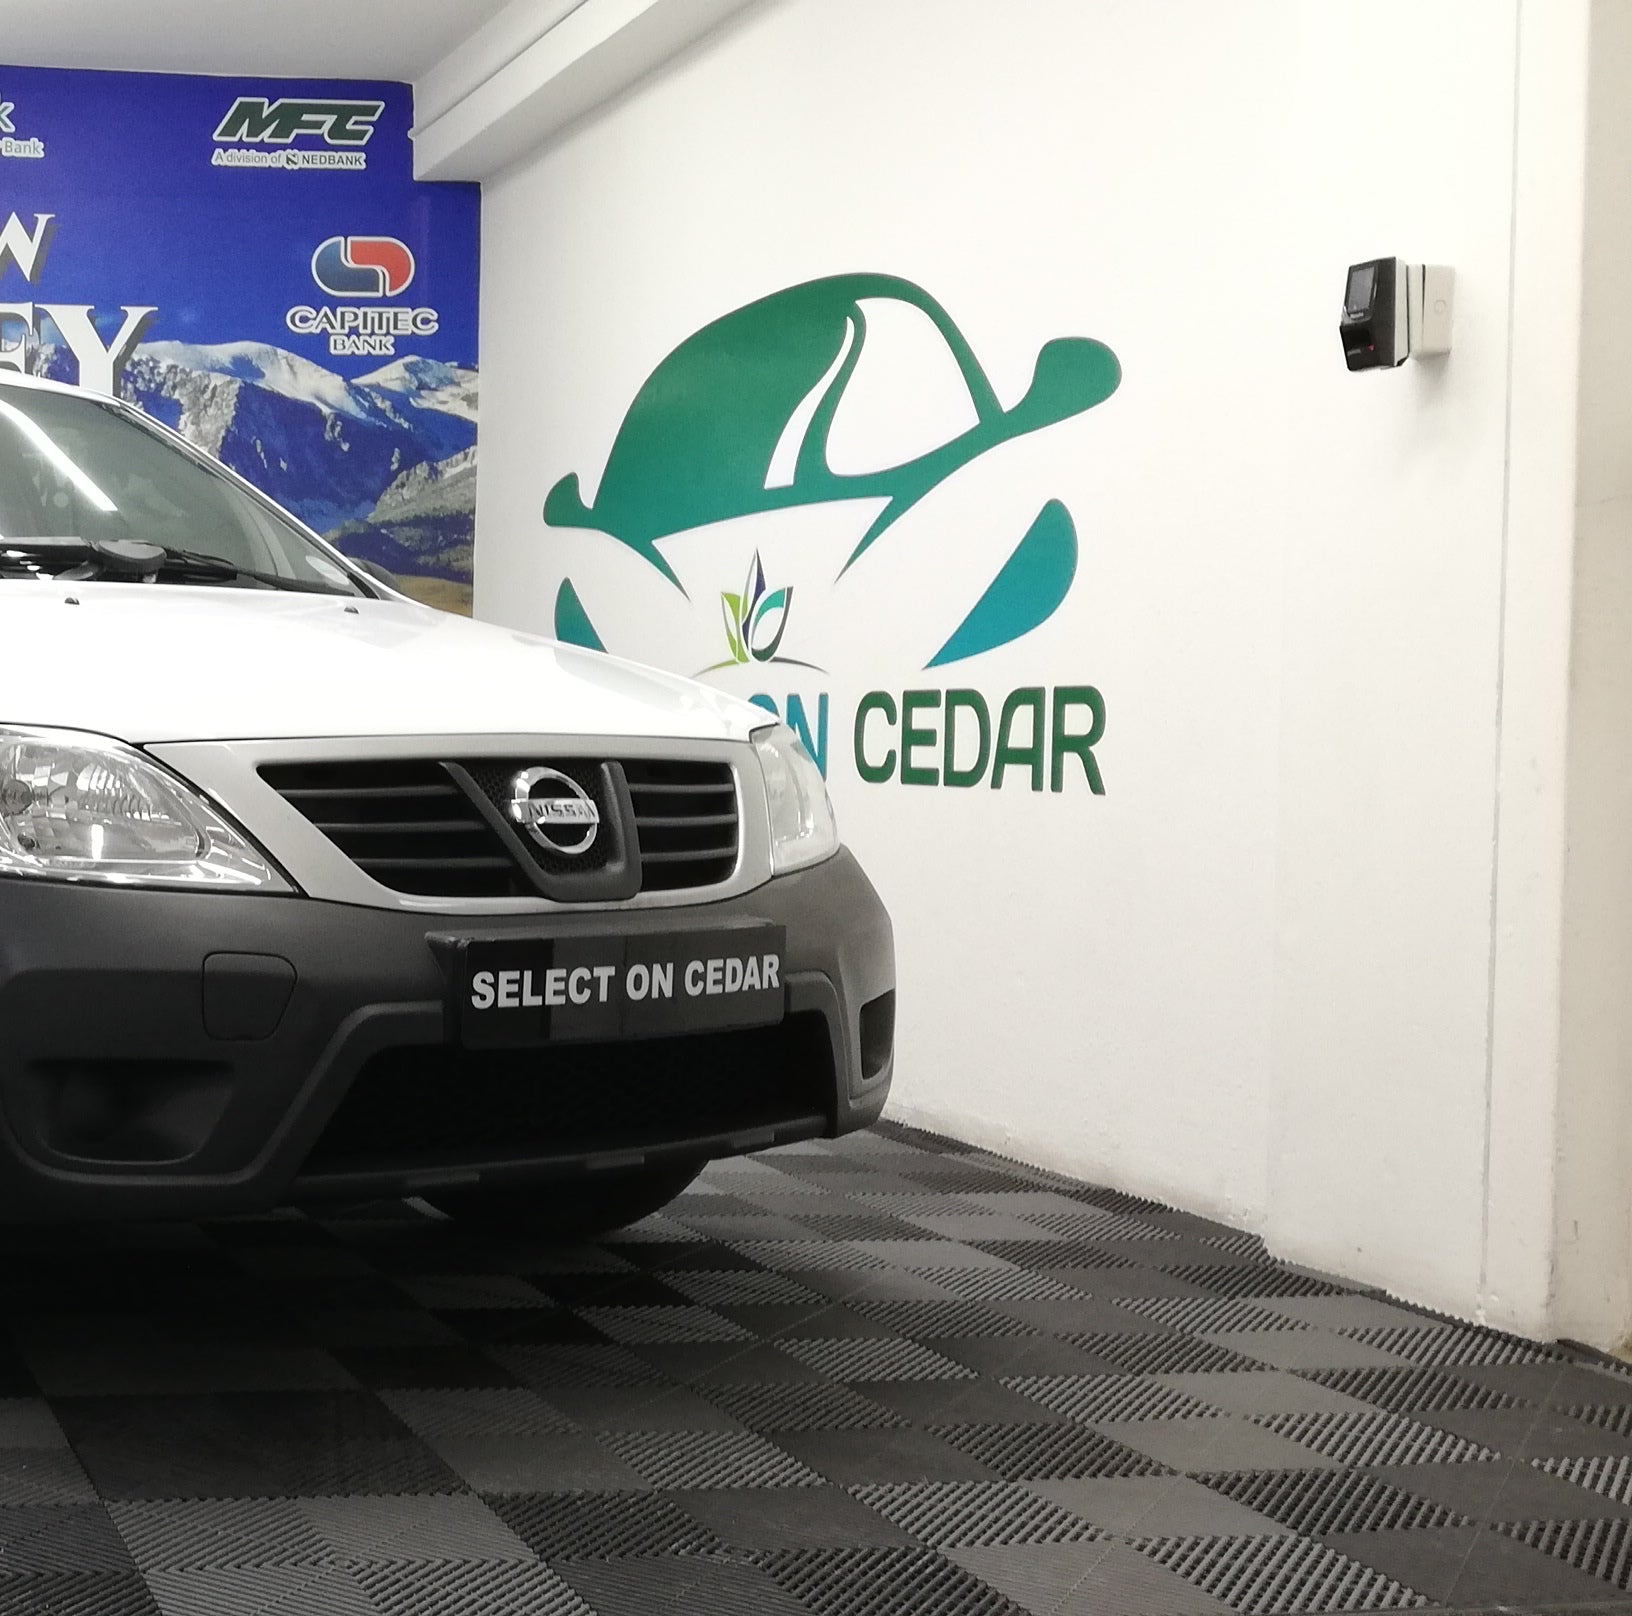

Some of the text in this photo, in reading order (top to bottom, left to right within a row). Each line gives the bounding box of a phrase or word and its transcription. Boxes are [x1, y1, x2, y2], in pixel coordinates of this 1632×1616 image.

[216, 100, 384, 142] MFC
[4, 139, 42, 156] Bank
[214, 152, 364, 166] A division of NEDBANK
[289, 308, 438, 332] CAPITEC
[333, 338, 394, 351] BANK
[853, 685, 1107, 796] CEDAR
[470, 953, 781, 1010] SELECT ON CEDAR
